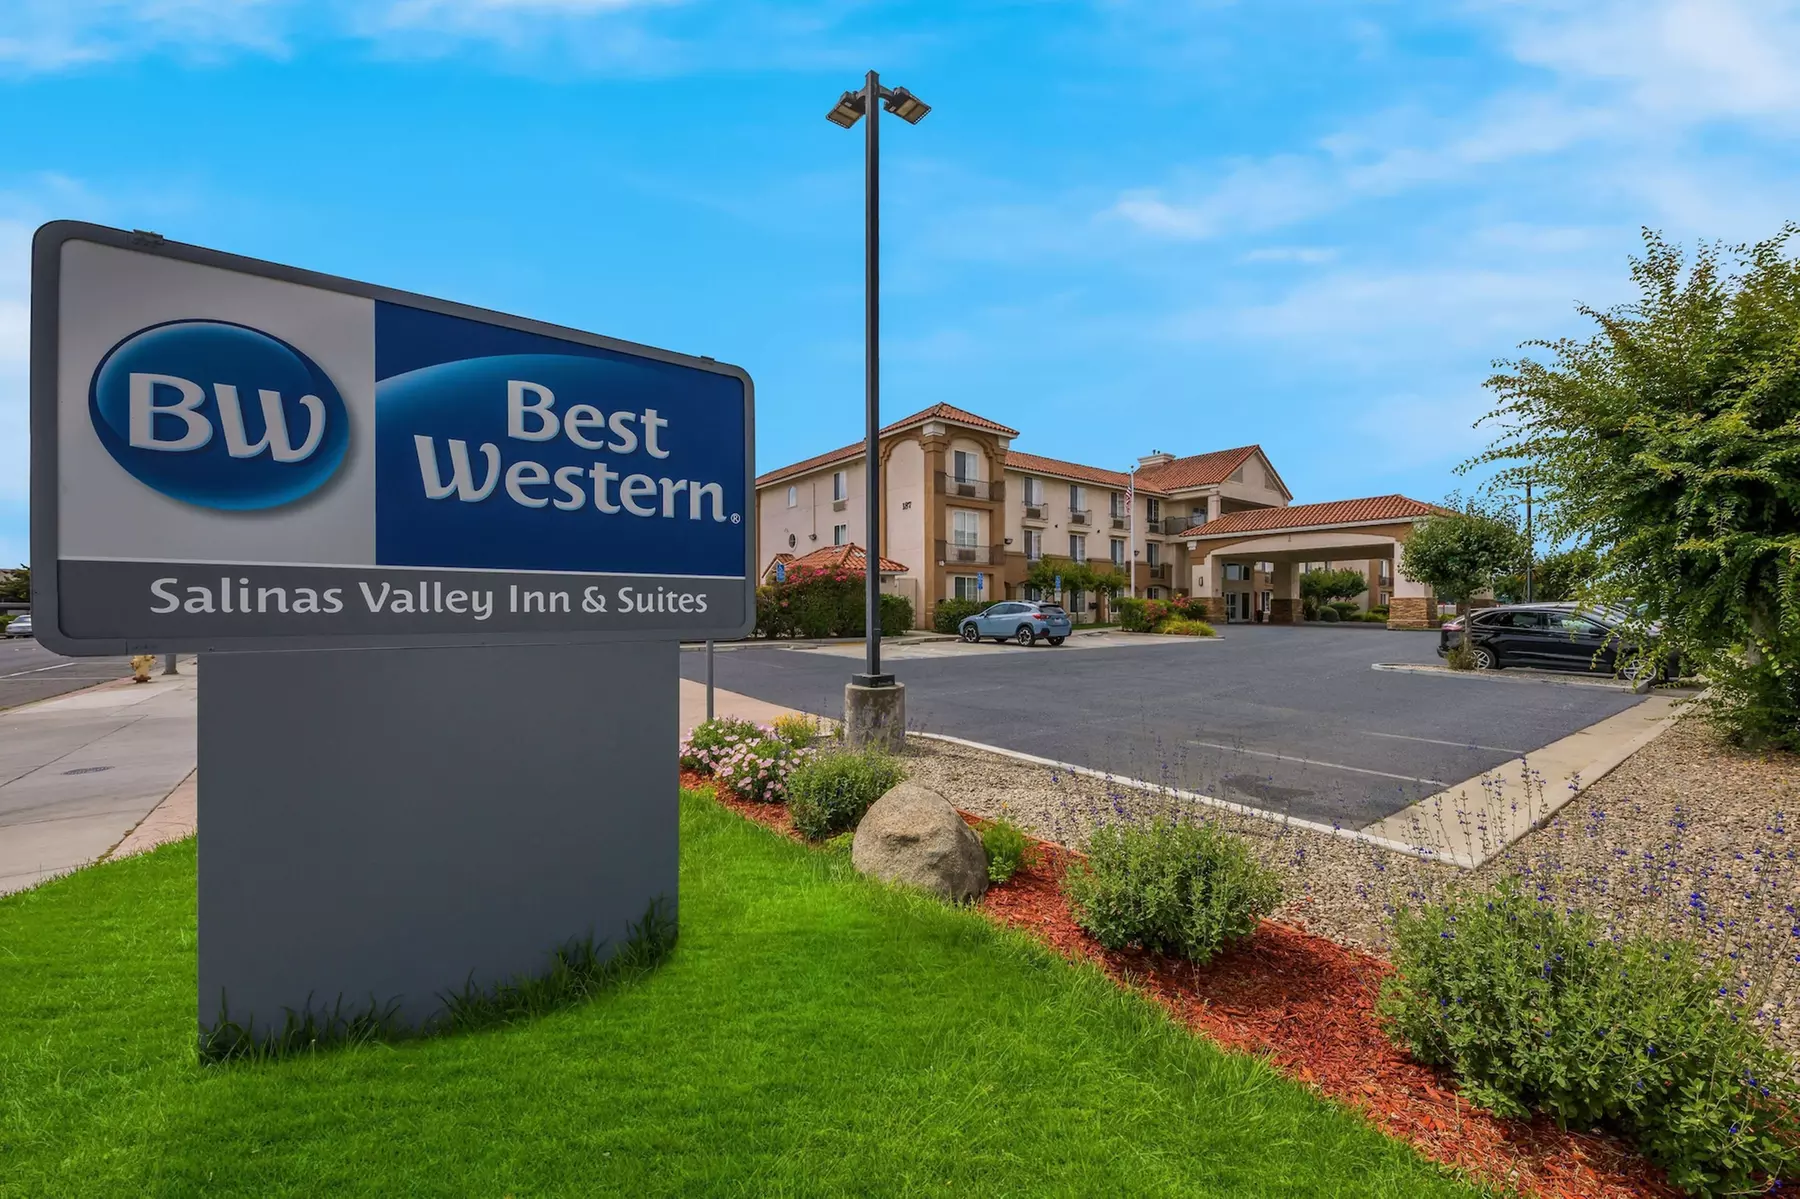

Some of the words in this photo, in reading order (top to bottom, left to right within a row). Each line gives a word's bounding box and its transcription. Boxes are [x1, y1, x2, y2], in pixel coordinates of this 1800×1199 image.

[129, 372, 326, 463] BW
[507, 380, 670, 459] Best
[414, 434, 727, 522] Western
[150, 577, 343, 613] Salinas
[359, 581, 493, 620] Valley
[510, 584, 571, 613] Inn
[581, 586, 608, 613] &
[617, 586, 708, 614] Suites
